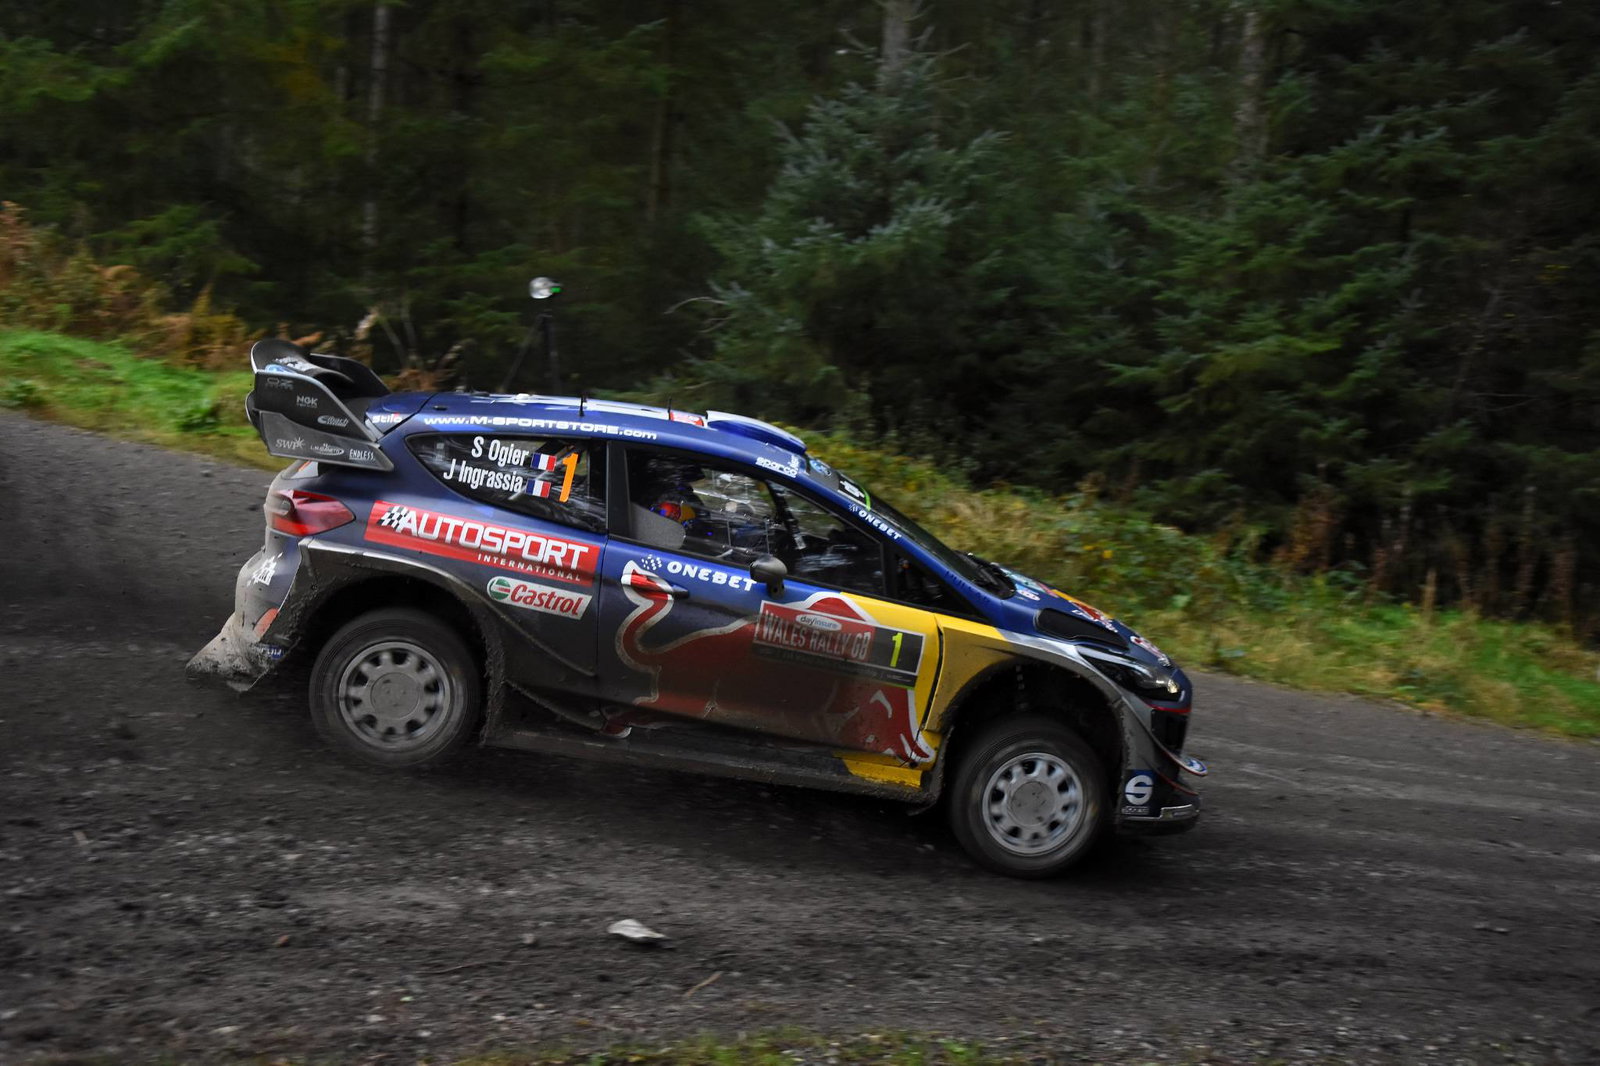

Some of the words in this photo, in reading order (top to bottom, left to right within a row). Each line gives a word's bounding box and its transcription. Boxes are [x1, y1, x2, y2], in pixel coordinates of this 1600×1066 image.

[296, 395, 318, 405] NGK
[372, 412, 403, 424] stilo
[424, 416, 657, 440] www.M-SPORTSTORE.com
[349, 448, 375, 461] ENDLESS
[471, 435, 485, 458] S
[488, 437, 529, 467] Ogier
[443, 458, 456, 480] J
[458, 460, 524, 493] Ingrassia
[558, 452, 579, 503] 1
[396, 510, 589, 570] AUTOSPORT
[858, 509, 902, 541] ONEBET
[477, 553, 581, 582] INTERNATIONAL
[666, 560, 757, 592] ONEBET
[510, 584, 583, 616] Castrol
[762, 610, 807, 648] WALES
[810, 628, 850, 659] RALLY
[852, 631, 872, 662] GB
[889, 632, 904, 668] 1
